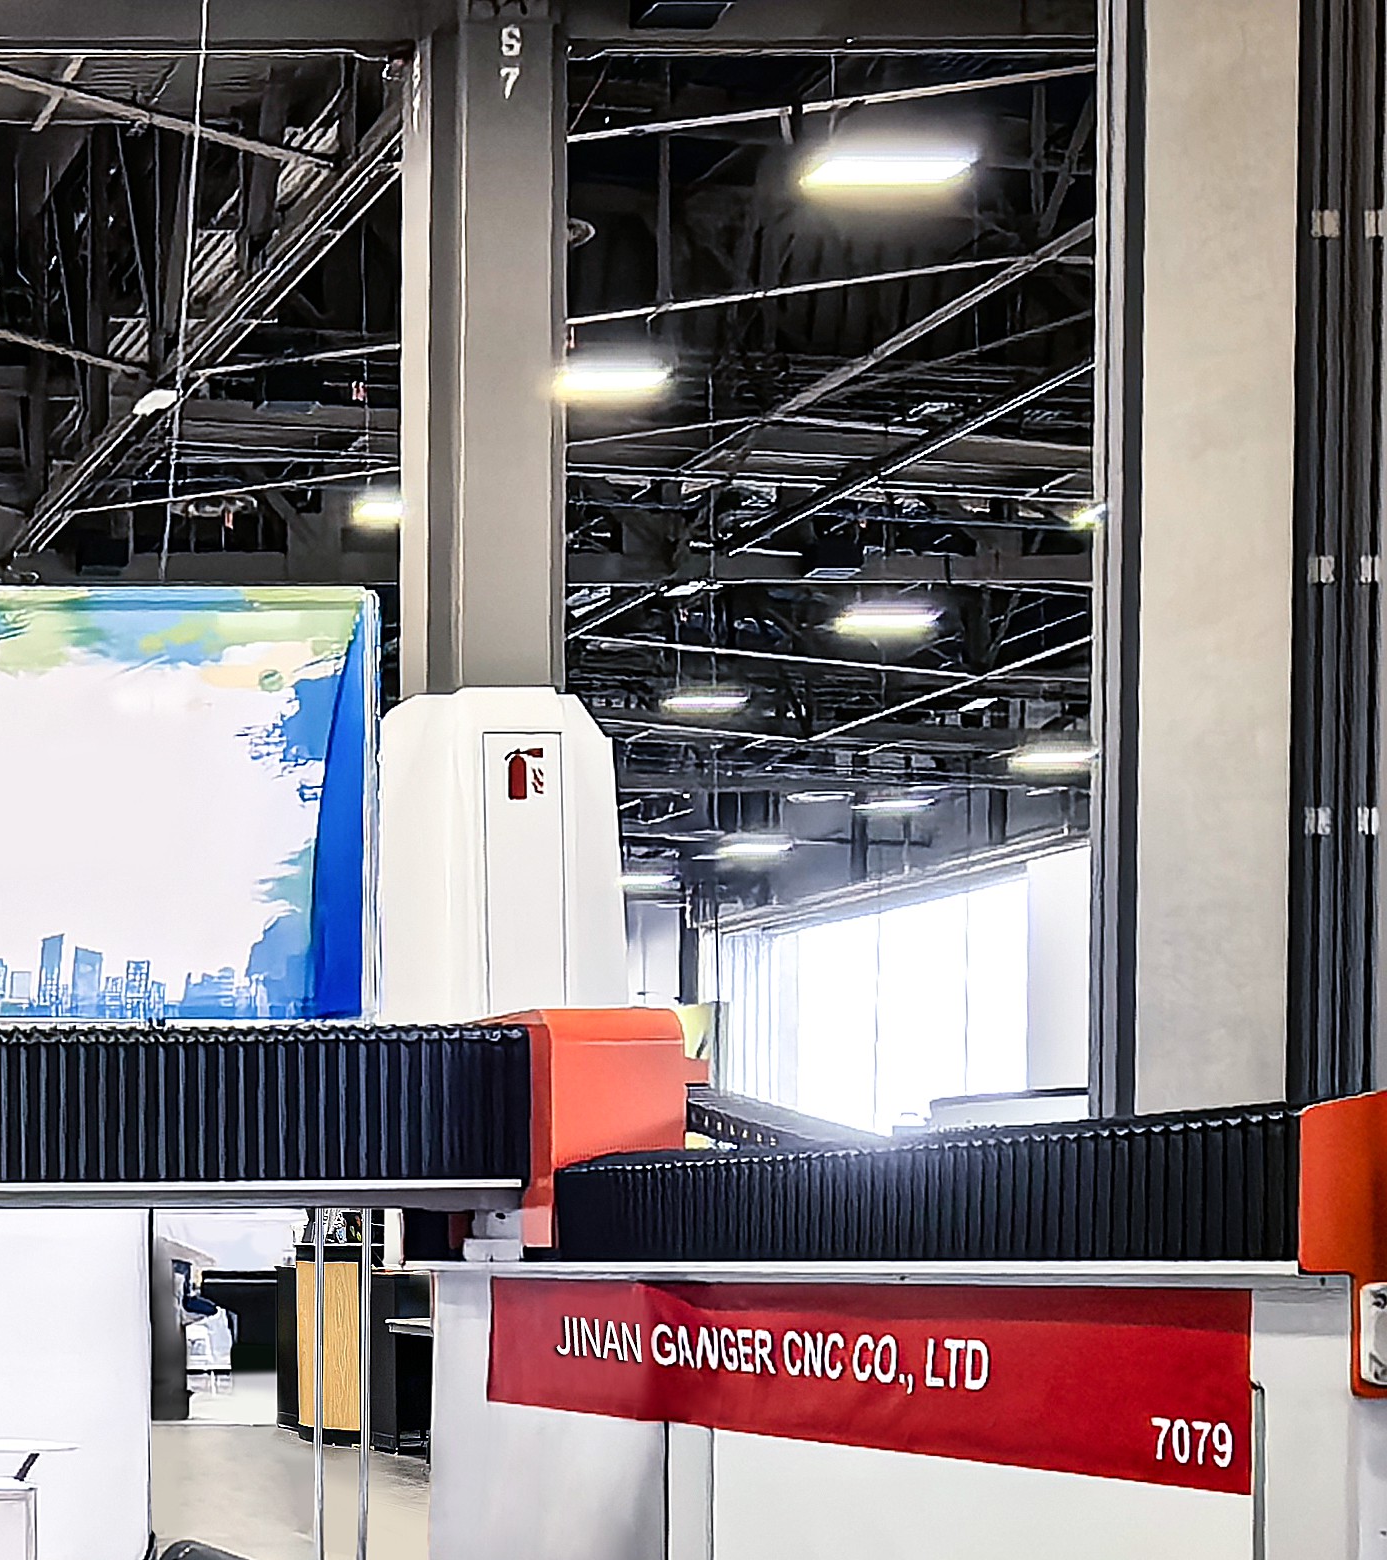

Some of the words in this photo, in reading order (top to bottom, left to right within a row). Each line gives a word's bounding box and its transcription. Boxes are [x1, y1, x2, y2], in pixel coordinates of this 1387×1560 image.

[556, 1316, 643, 1363] JINAN
[650, 1323, 776, 1375] GANGER
[783, 1330, 845, 1380] CNC
[852, 1334, 914, 1395] CO.,
[925, 1338, 989, 1391] LTD
[1151, 1417, 1233, 1468] 7079
